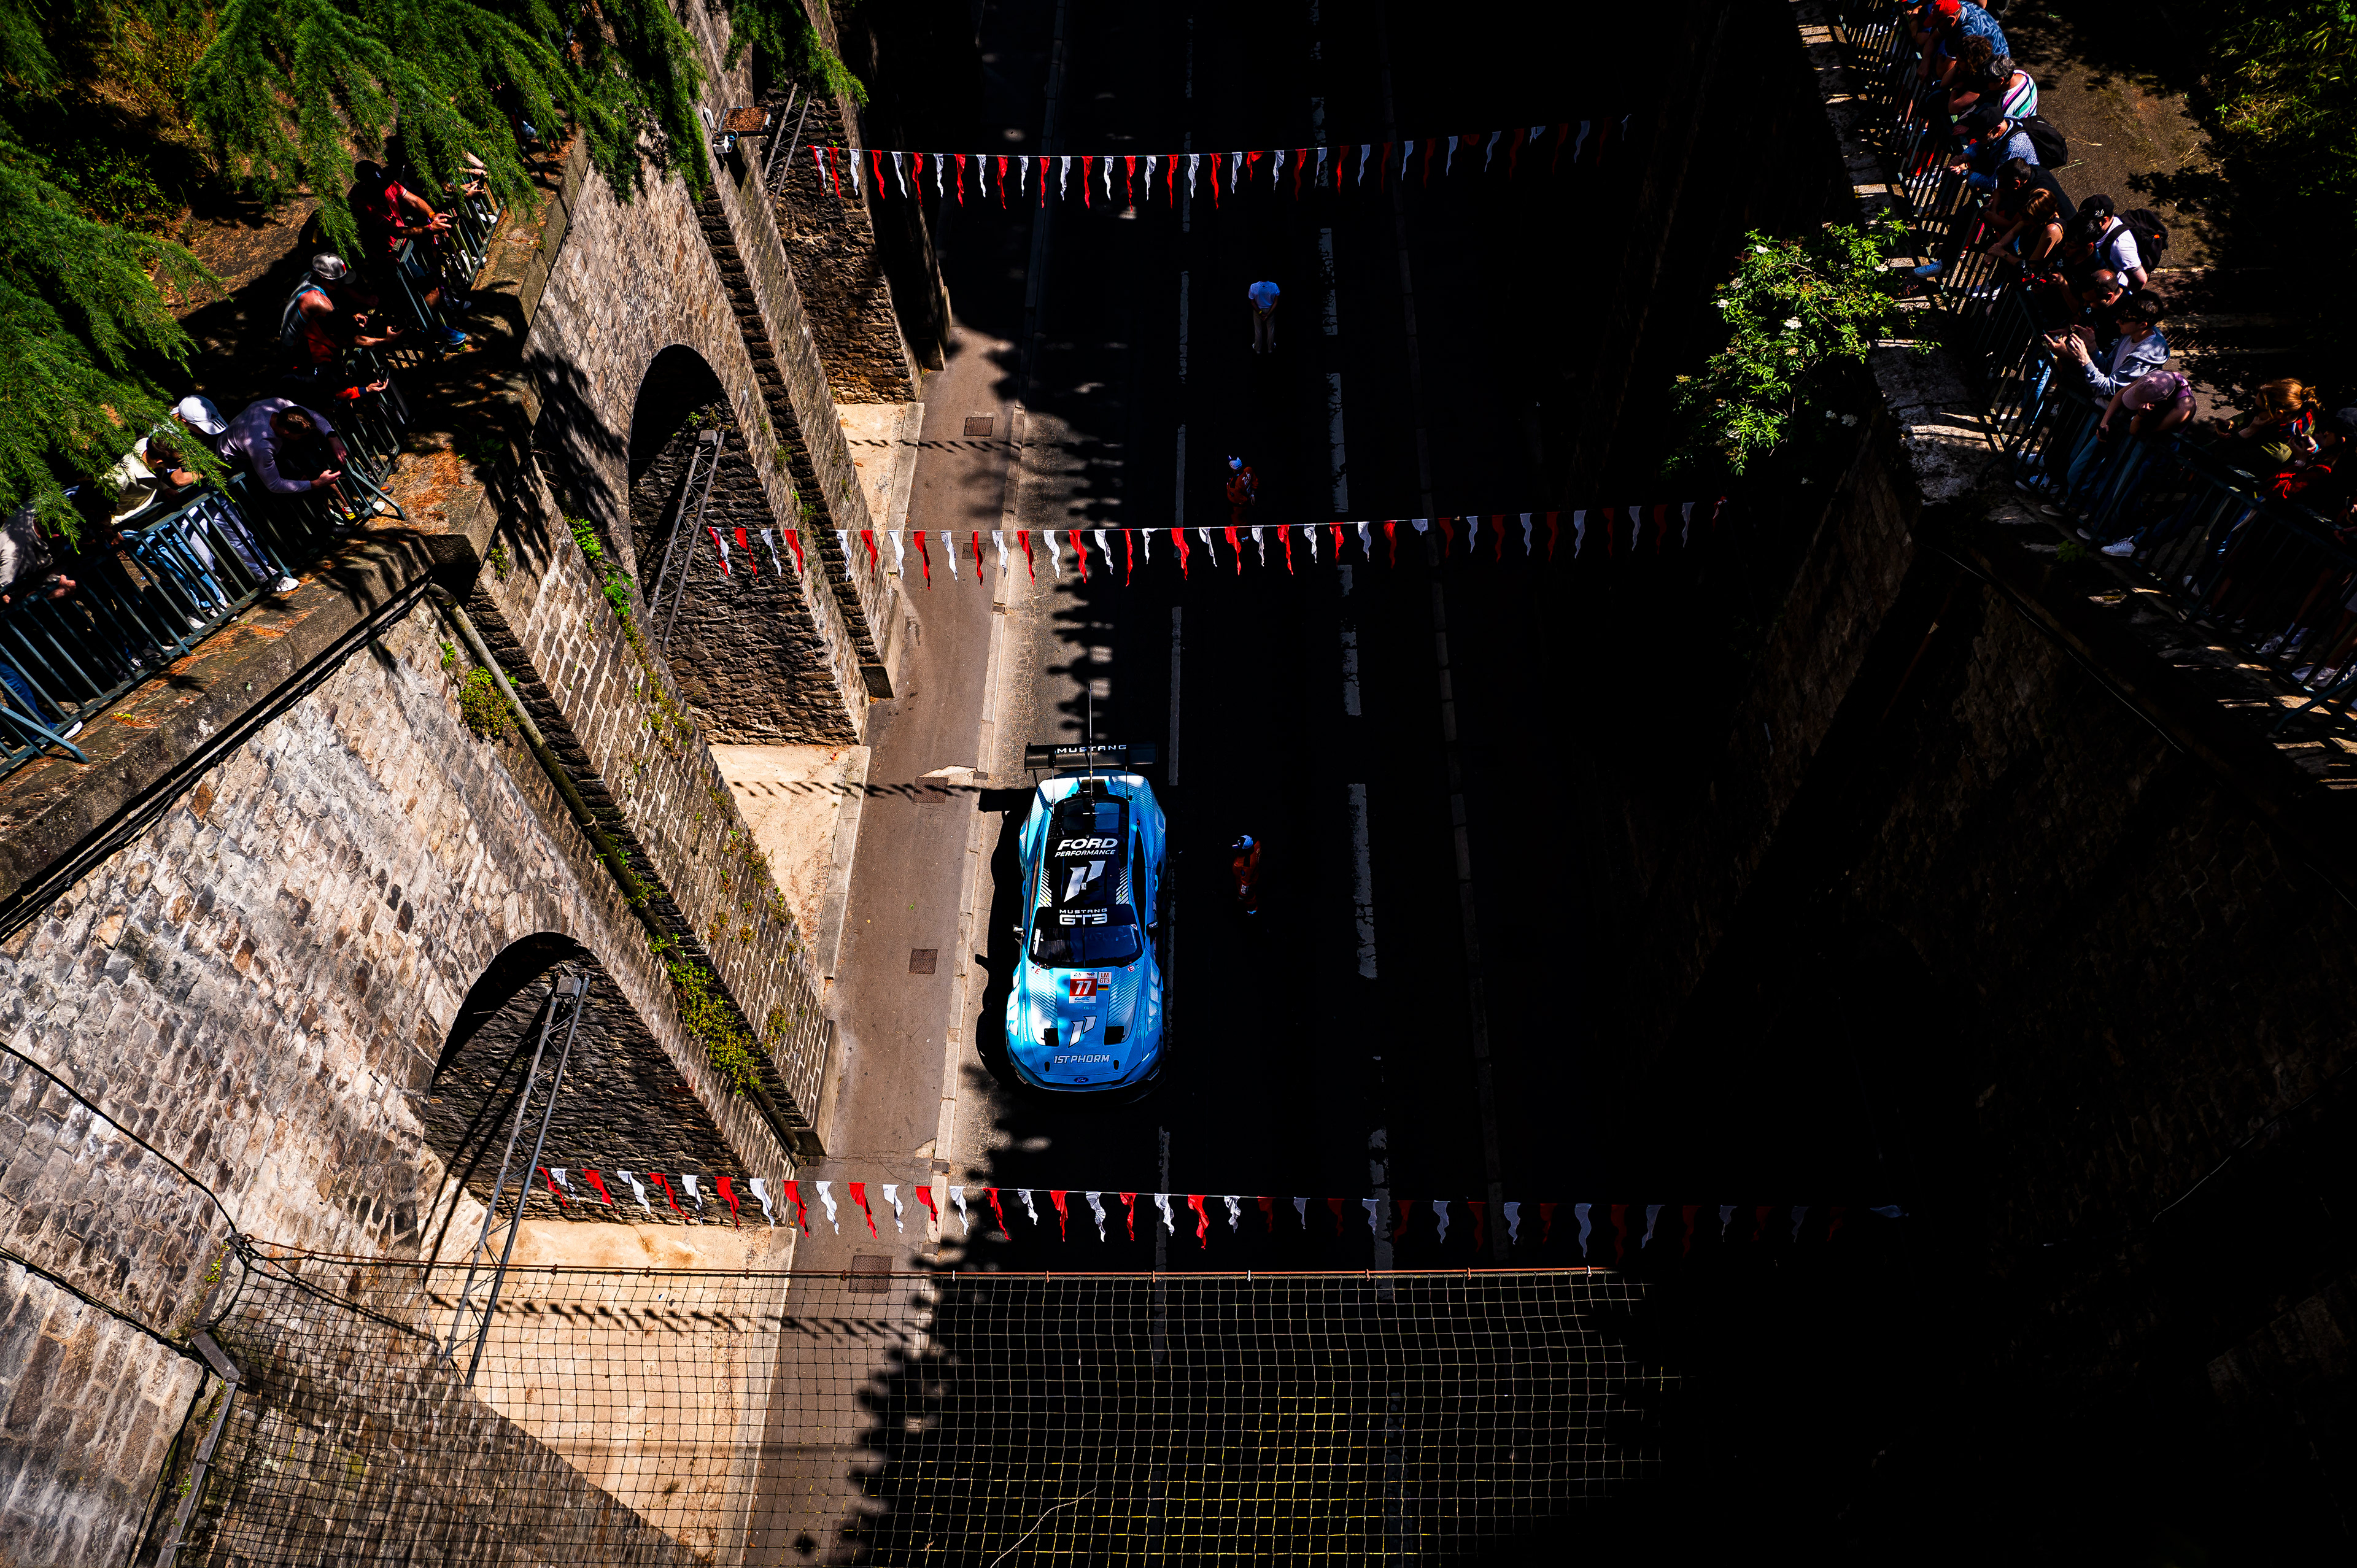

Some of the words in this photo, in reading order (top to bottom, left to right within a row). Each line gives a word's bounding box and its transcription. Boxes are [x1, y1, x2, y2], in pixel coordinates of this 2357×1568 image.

[1057, 744, 1126, 754] MUSTANG
[1057, 838, 1118, 851] FORD
[1059, 913, 1107, 925] GT3
[1075, 980, 1092, 995] 77
[1070, 1054, 1110, 1063] PHORM
